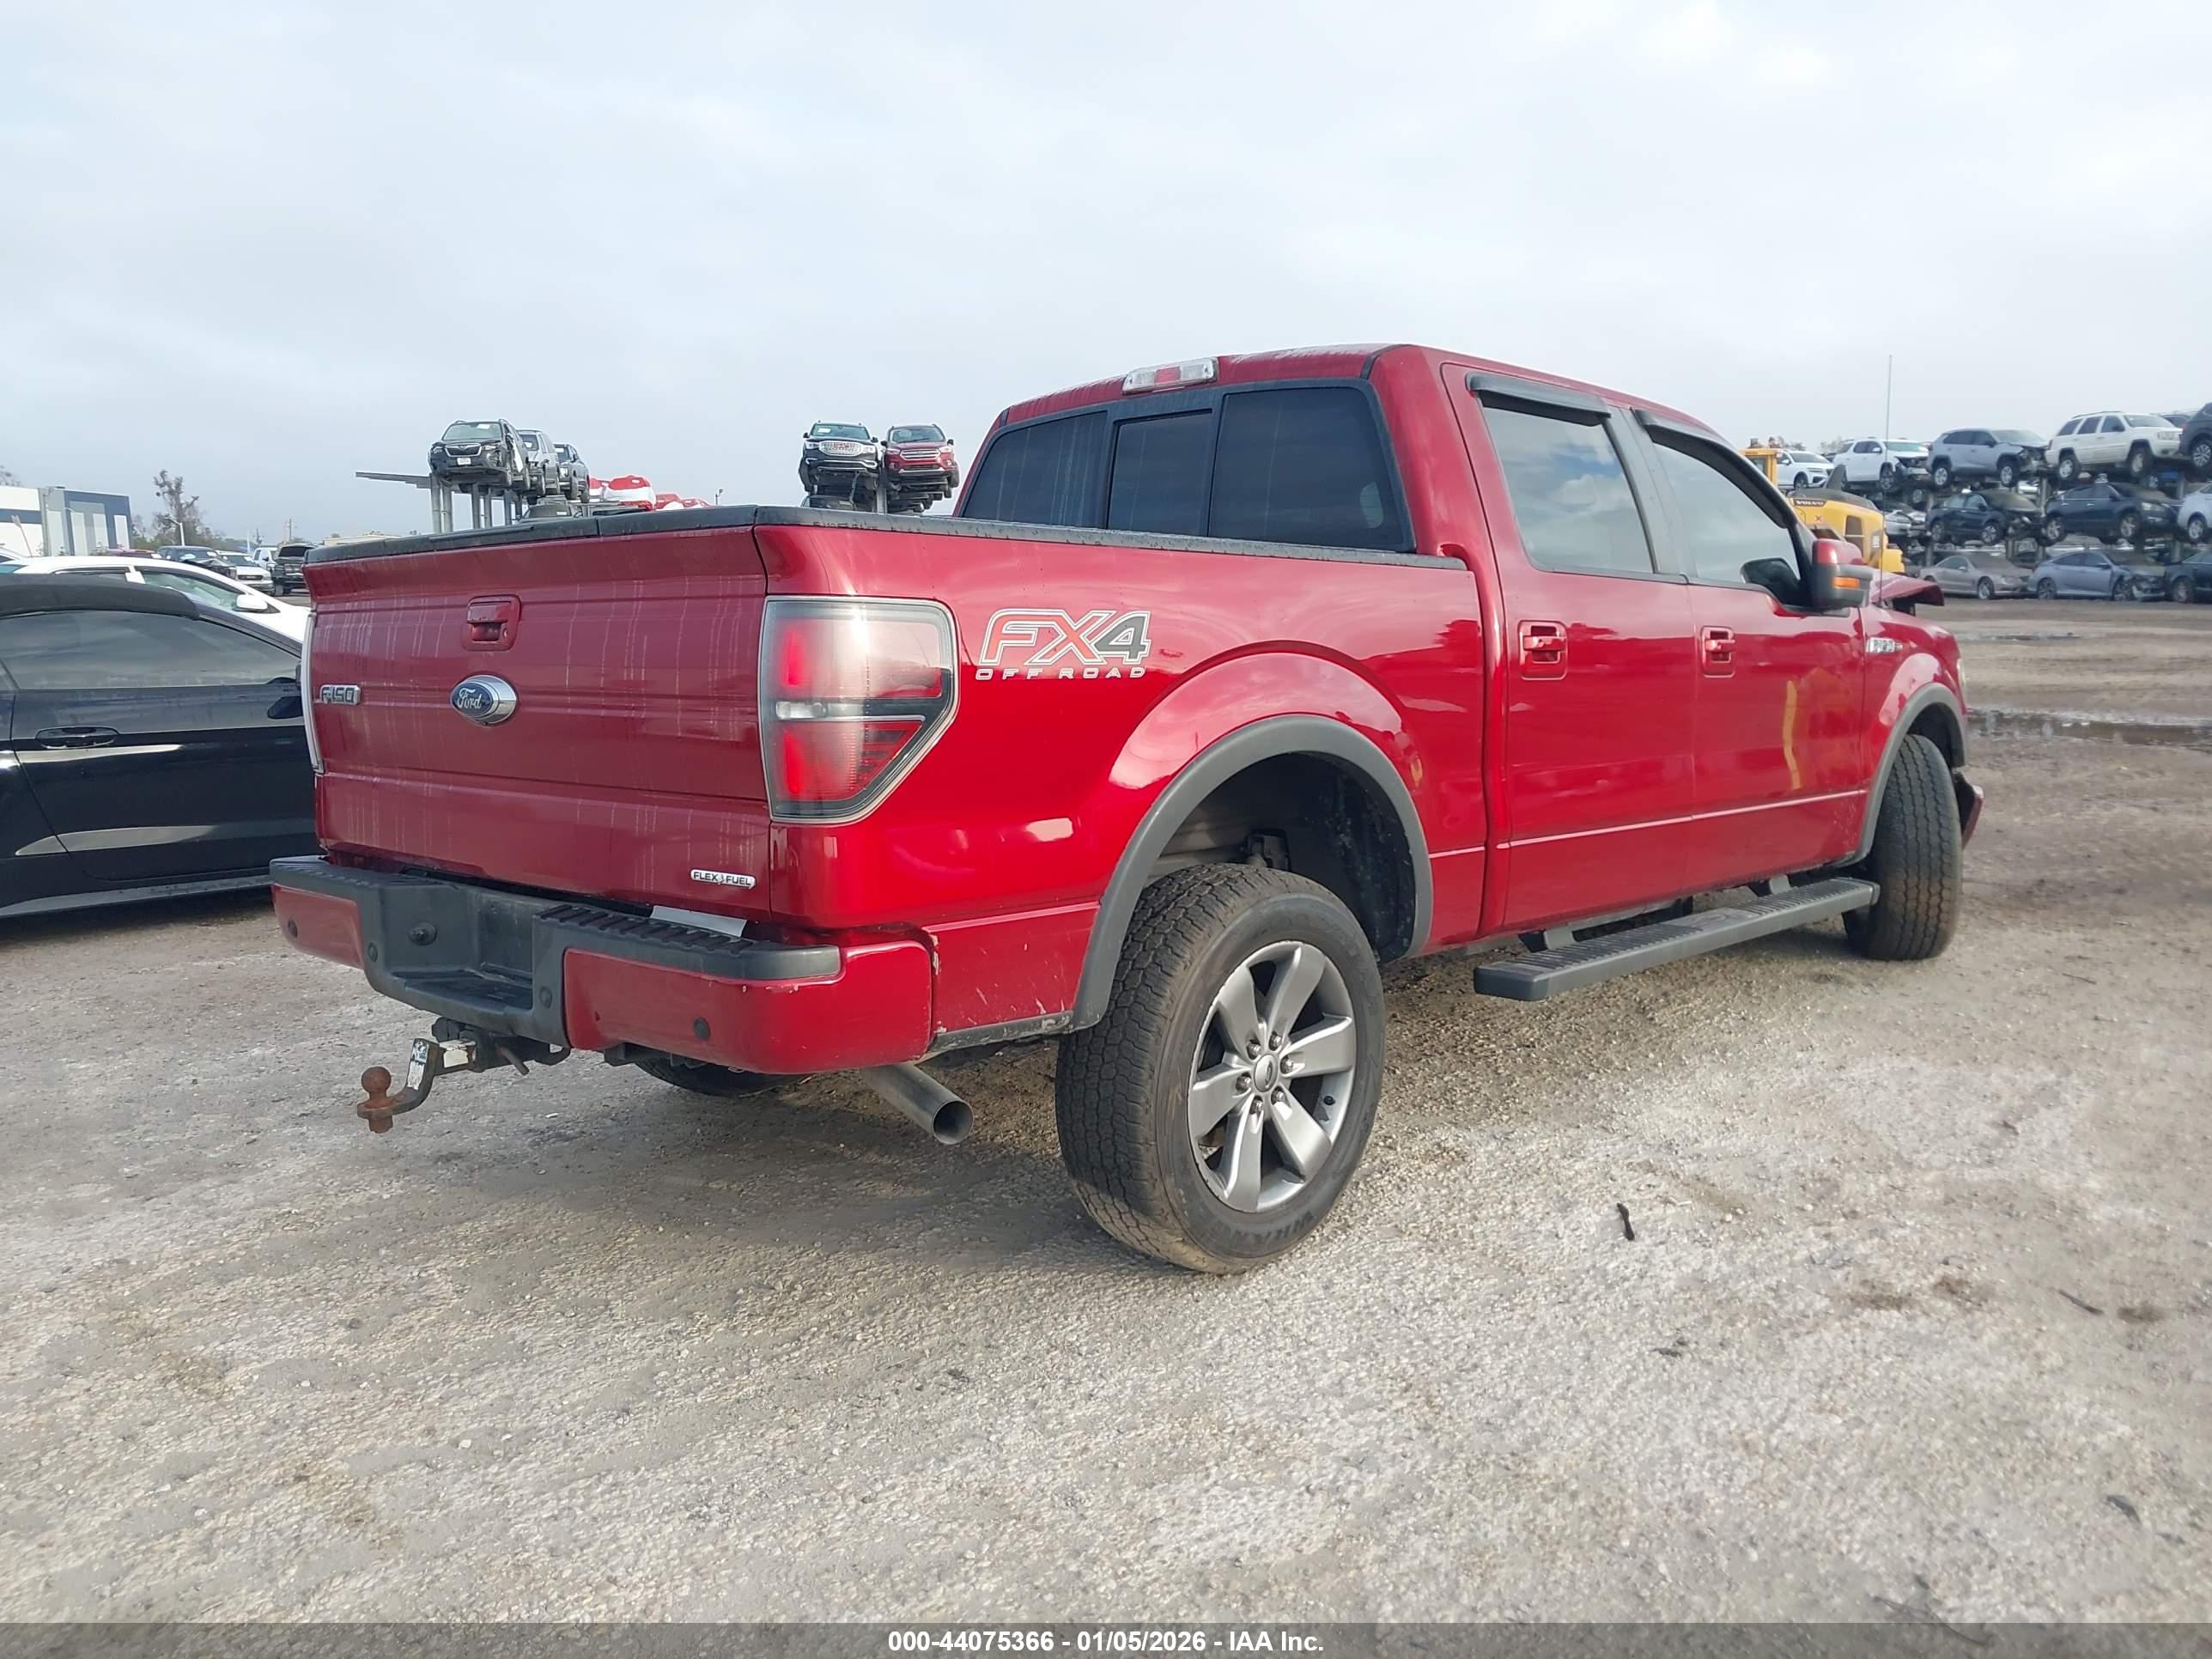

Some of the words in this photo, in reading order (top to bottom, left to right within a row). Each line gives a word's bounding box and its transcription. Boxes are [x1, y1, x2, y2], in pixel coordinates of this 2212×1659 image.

[978, 608, 1152, 665] FX4
[975, 667, 1042, 680] OFF
[1058, 667, 1146, 679] ROAD
[457, 687, 483, 709] Ford
[693, 872, 718, 882] FLEX
[726, 875, 751, 886] FUEL
